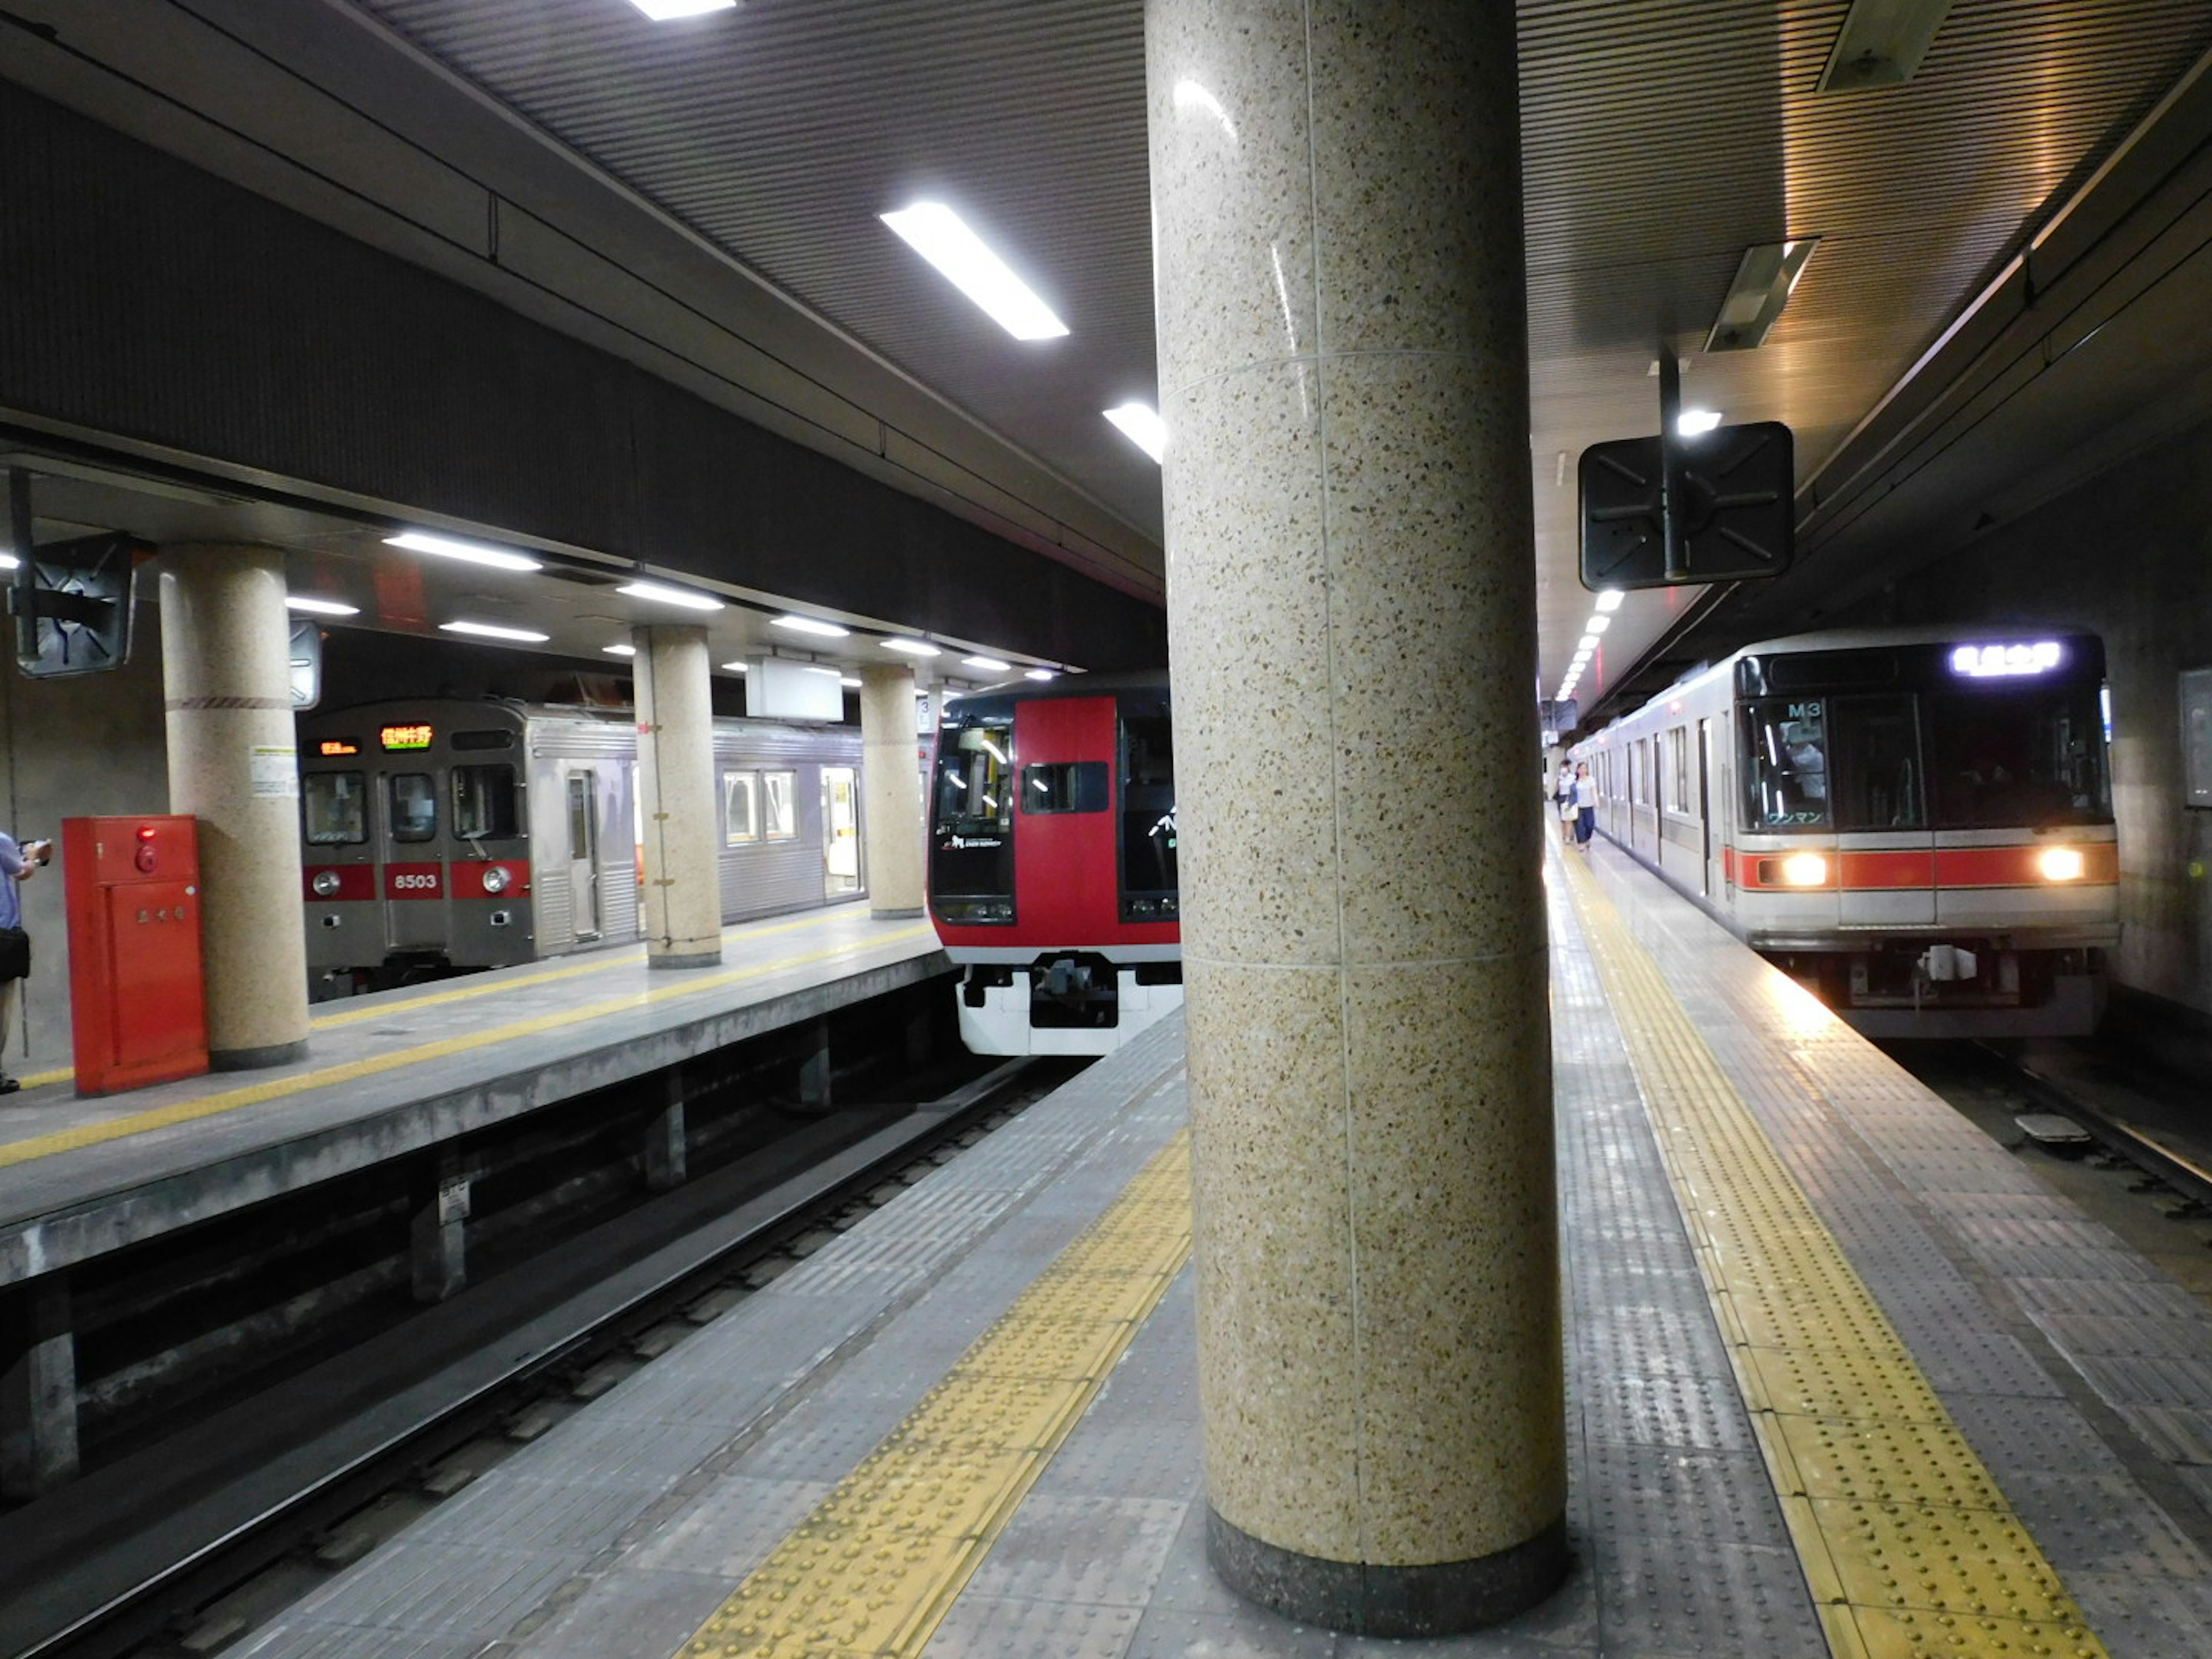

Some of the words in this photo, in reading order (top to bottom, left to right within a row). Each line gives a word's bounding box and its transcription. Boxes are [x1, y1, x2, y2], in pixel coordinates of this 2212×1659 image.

[922, 702, 929, 713] 3
[1788, 703, 1821, 718] M3
[1768, 811, 1823, 824] ワンマン
[395, 874, 437, 889] 8503
